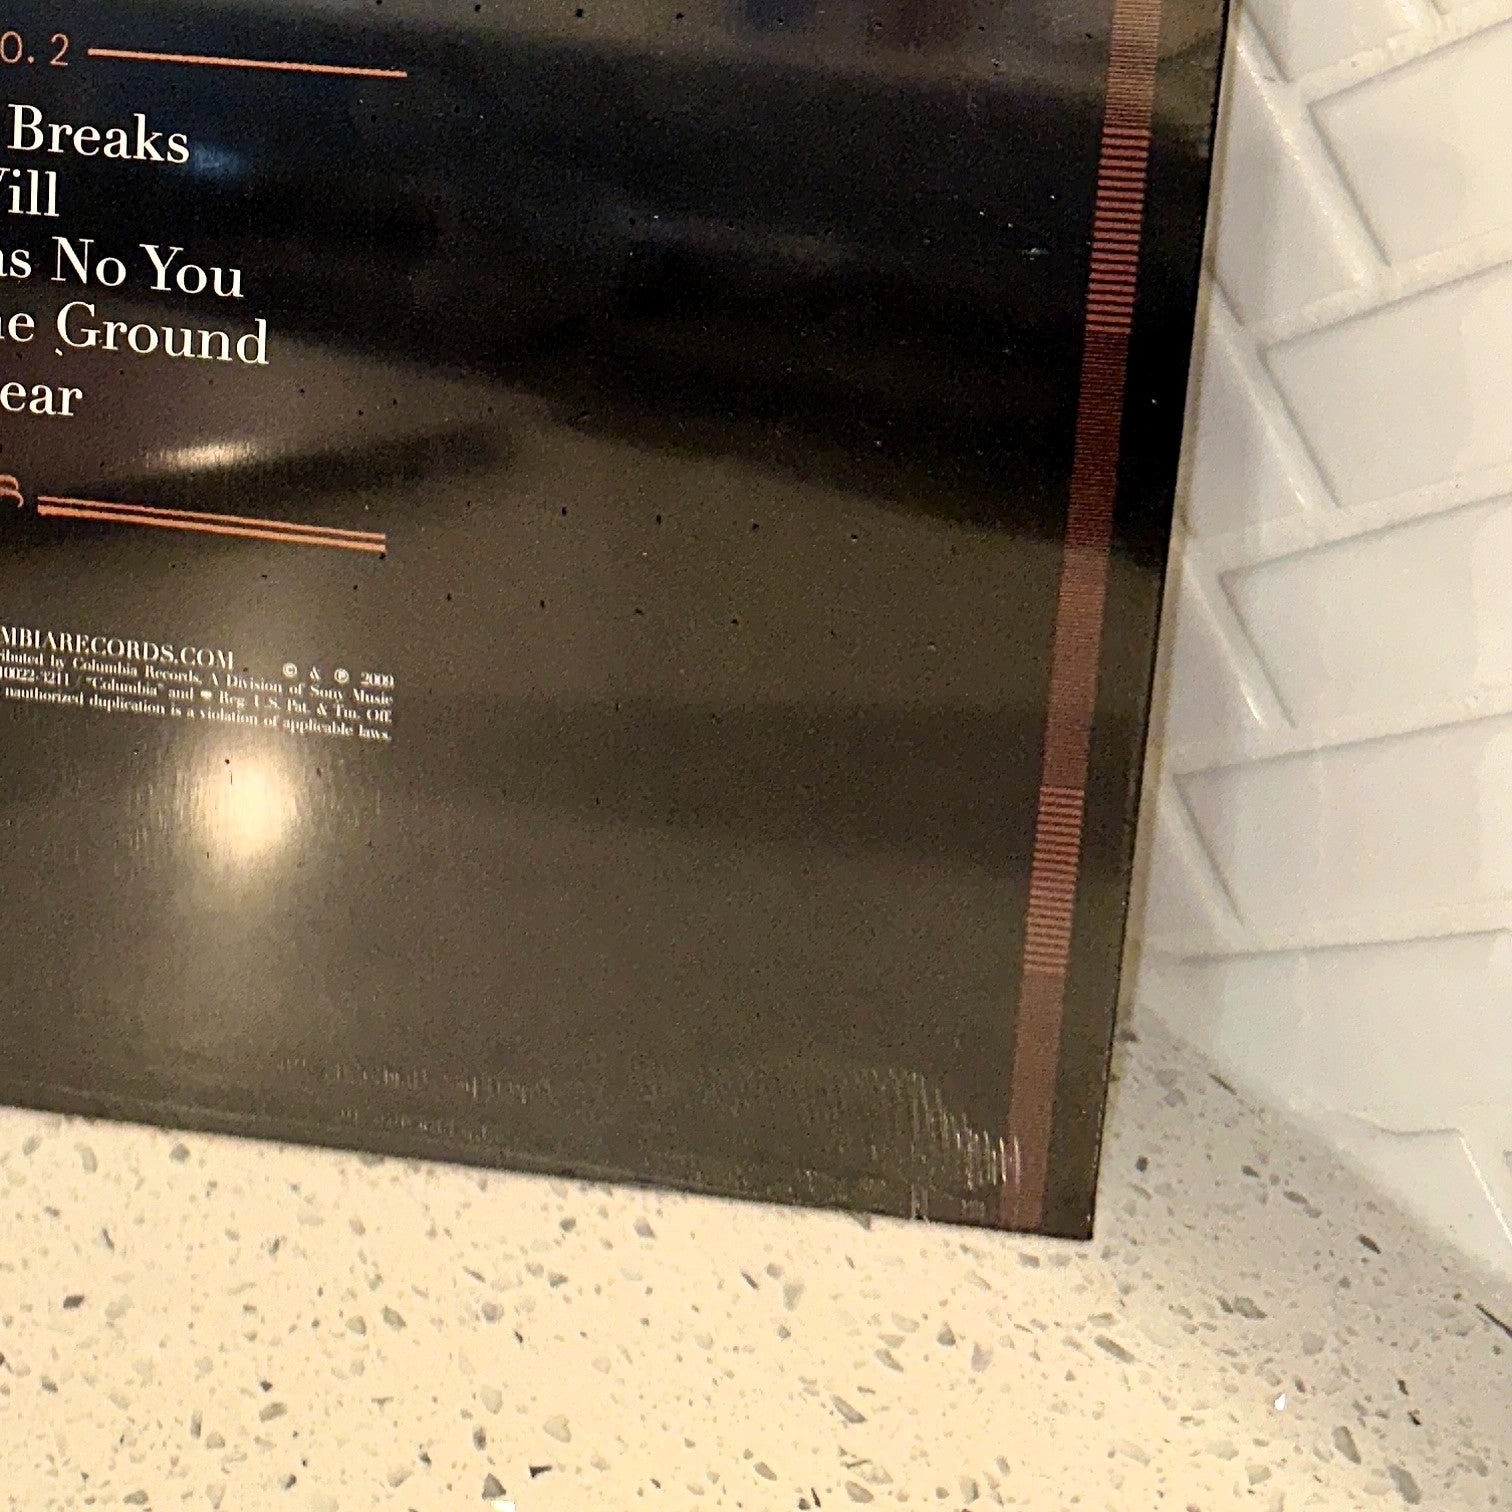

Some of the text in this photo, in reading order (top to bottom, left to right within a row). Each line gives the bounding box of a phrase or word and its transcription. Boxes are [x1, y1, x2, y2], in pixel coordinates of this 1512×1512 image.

[50, 34, 70, 67] 2
[7, 103, 190, 164] Breaks
[52, 237, 127, 288] No
[139, 243, 244, 298] You
[55, 301, 270, 365] Ground
[51, 654, 64, 669] by
[73, 657, 138, 677] Columbia
[226, 674, 282, 694] Division
[289, 683, 305, 695] of
[310, 685, 343, 702] Sony
[352, 688, 394, 705] Music
[168, 687, 194, 702] and
[360, 672, 395, 688] 2009
[89, 691, 165, 715] duplication
[170, 702, 182, 716] is
[200, 706, 258, 726] violation
[264, 714, 280, 727] of
[283, 719, 354, 737] applicable
